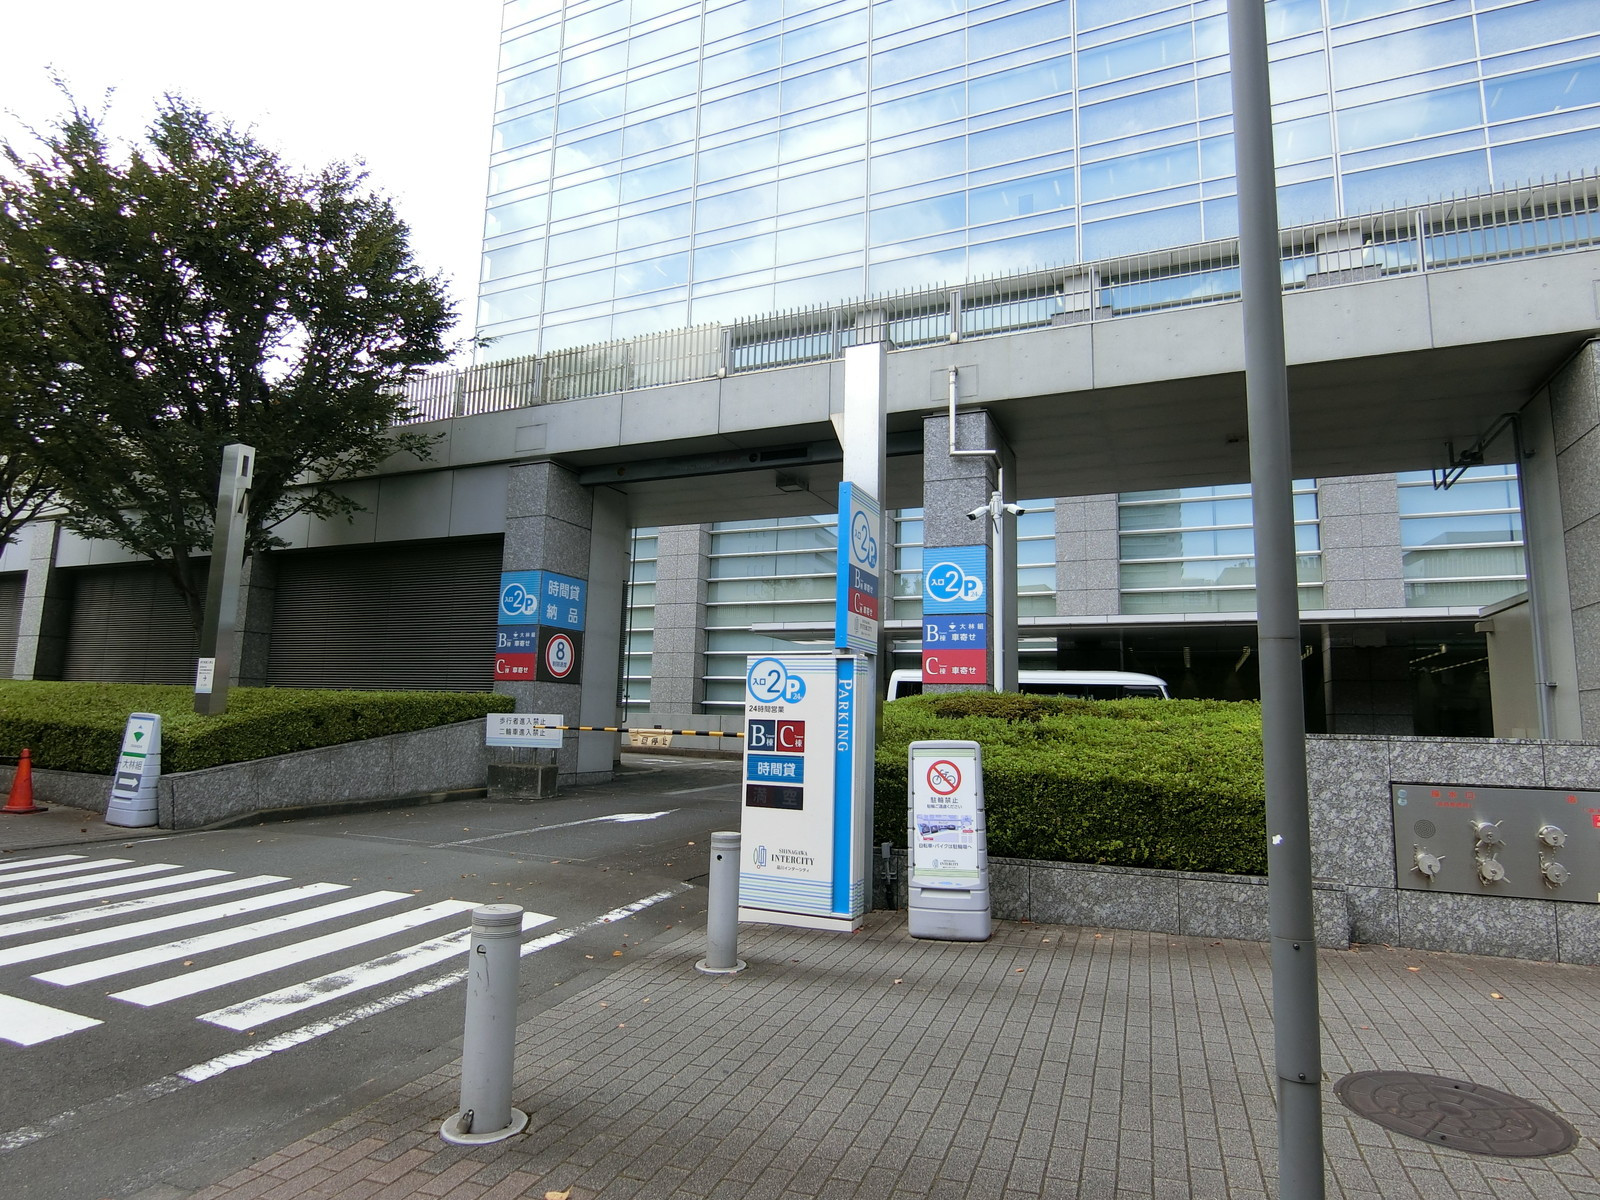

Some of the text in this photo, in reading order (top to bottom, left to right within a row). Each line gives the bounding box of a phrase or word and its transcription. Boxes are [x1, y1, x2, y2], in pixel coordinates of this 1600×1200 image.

[861, 524, 868, 552] 2
[869, 540, 875, 564] P
[945, 571, 959, 592] 2
[964, 580, 977, 597] P
[548, 580, 580, 602] 時間貸
[513, 590, 523, 608] 2
[524, 597, 533, 612] P
[951, 633, 976, 642] 車寄せ
[556, 641, 565, 660] 8
[951, 666, 976, 675] 車寄せ
[752, 678, 766, 686] 入口
[767, 669, 781, 693] 2
[785, 679, 800, 699] P
[749, 705, 785, 714] 24時間営業
[837, 679, 853, 752] PARKING
[499, 717, 546, 725] 歩行者進入禁止
[499, 728, 546, 736] 二輪車進入禁止
[122, 759, 143, 771] 大林組
[757, 762, 796, 777] 時間貸
[778, 848, 808, 856] SHINAGAWA
[771, 854, 814, 866] INTERCITY
